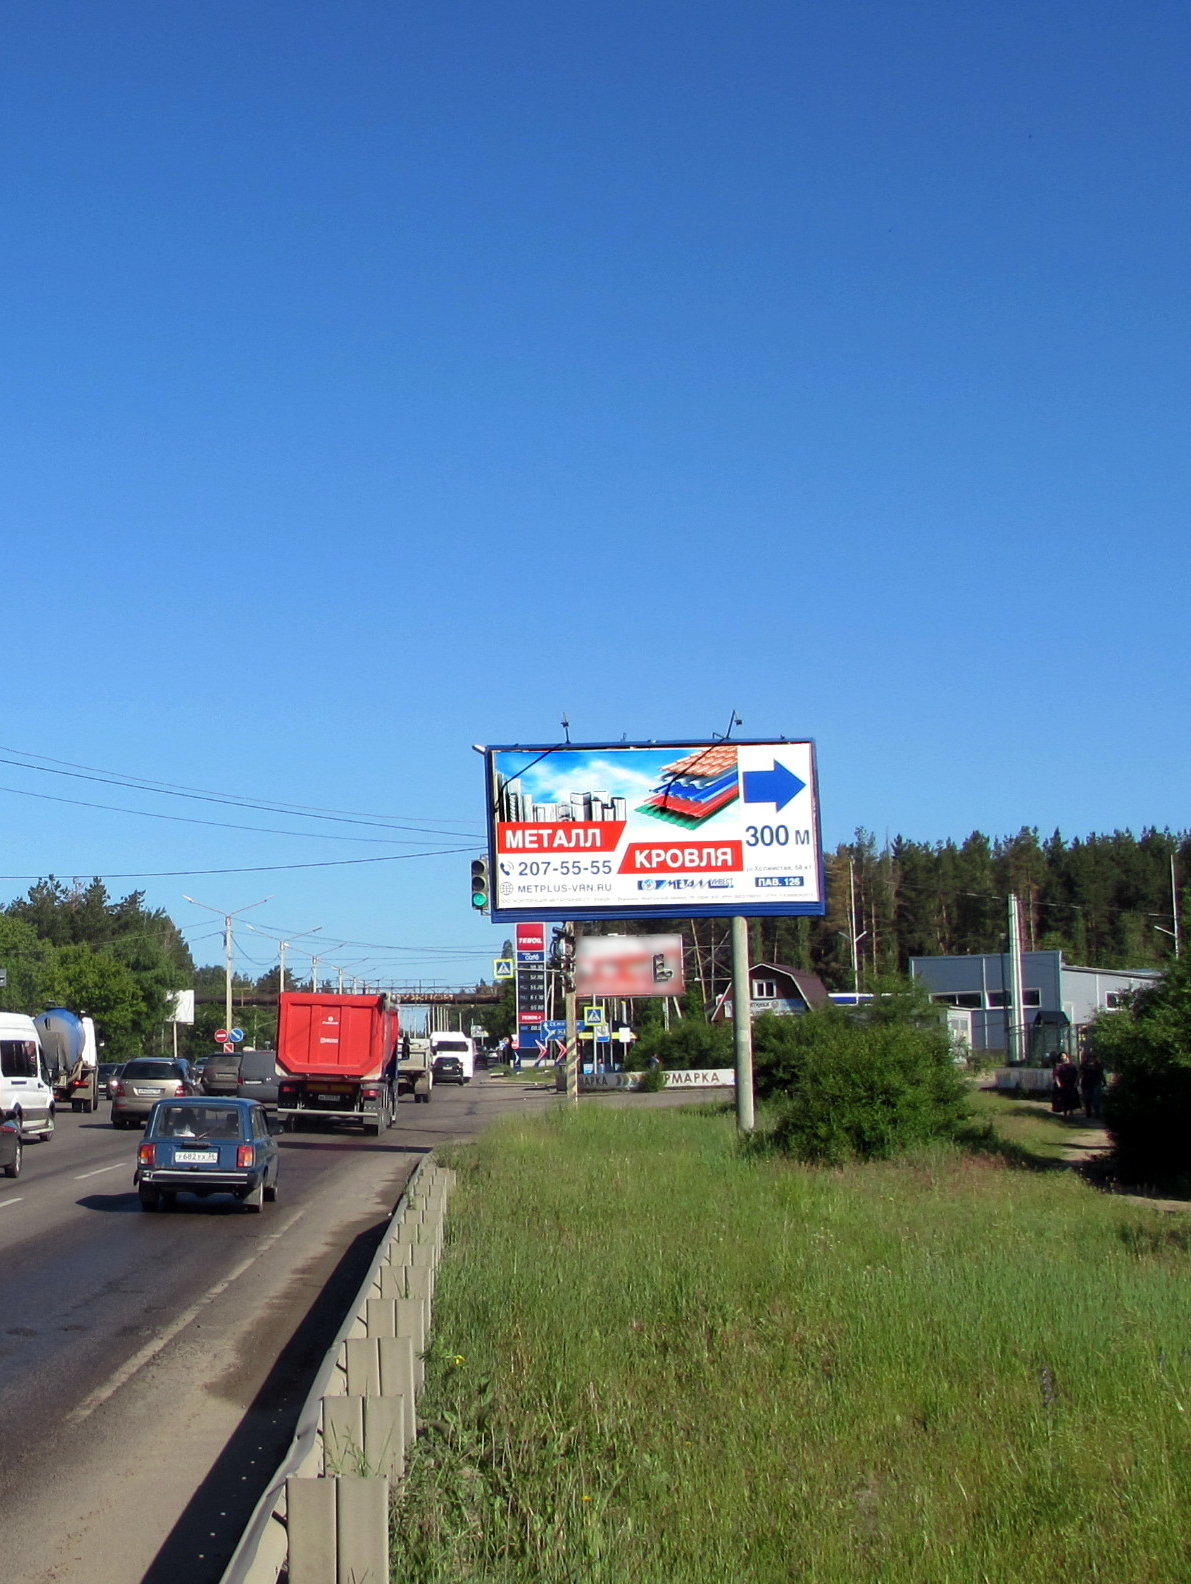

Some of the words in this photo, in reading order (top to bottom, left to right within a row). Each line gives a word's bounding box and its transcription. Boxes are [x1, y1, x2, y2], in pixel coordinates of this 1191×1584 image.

[505, 828, 602, 849] МЕТАЛЛ
[745, 824, 790, 847] 300
[634, 847, 733, 869] КРОВЛЯ
[518, 860, 612, 876] 207-55-55
[517, 883, 612, 893] METPLUS-VRN.RU
[758, 878, 782, 887] ПАВ.
[783, 877, 801, 886] 126
[664, 1072, 720, 1084] РМАРКА
